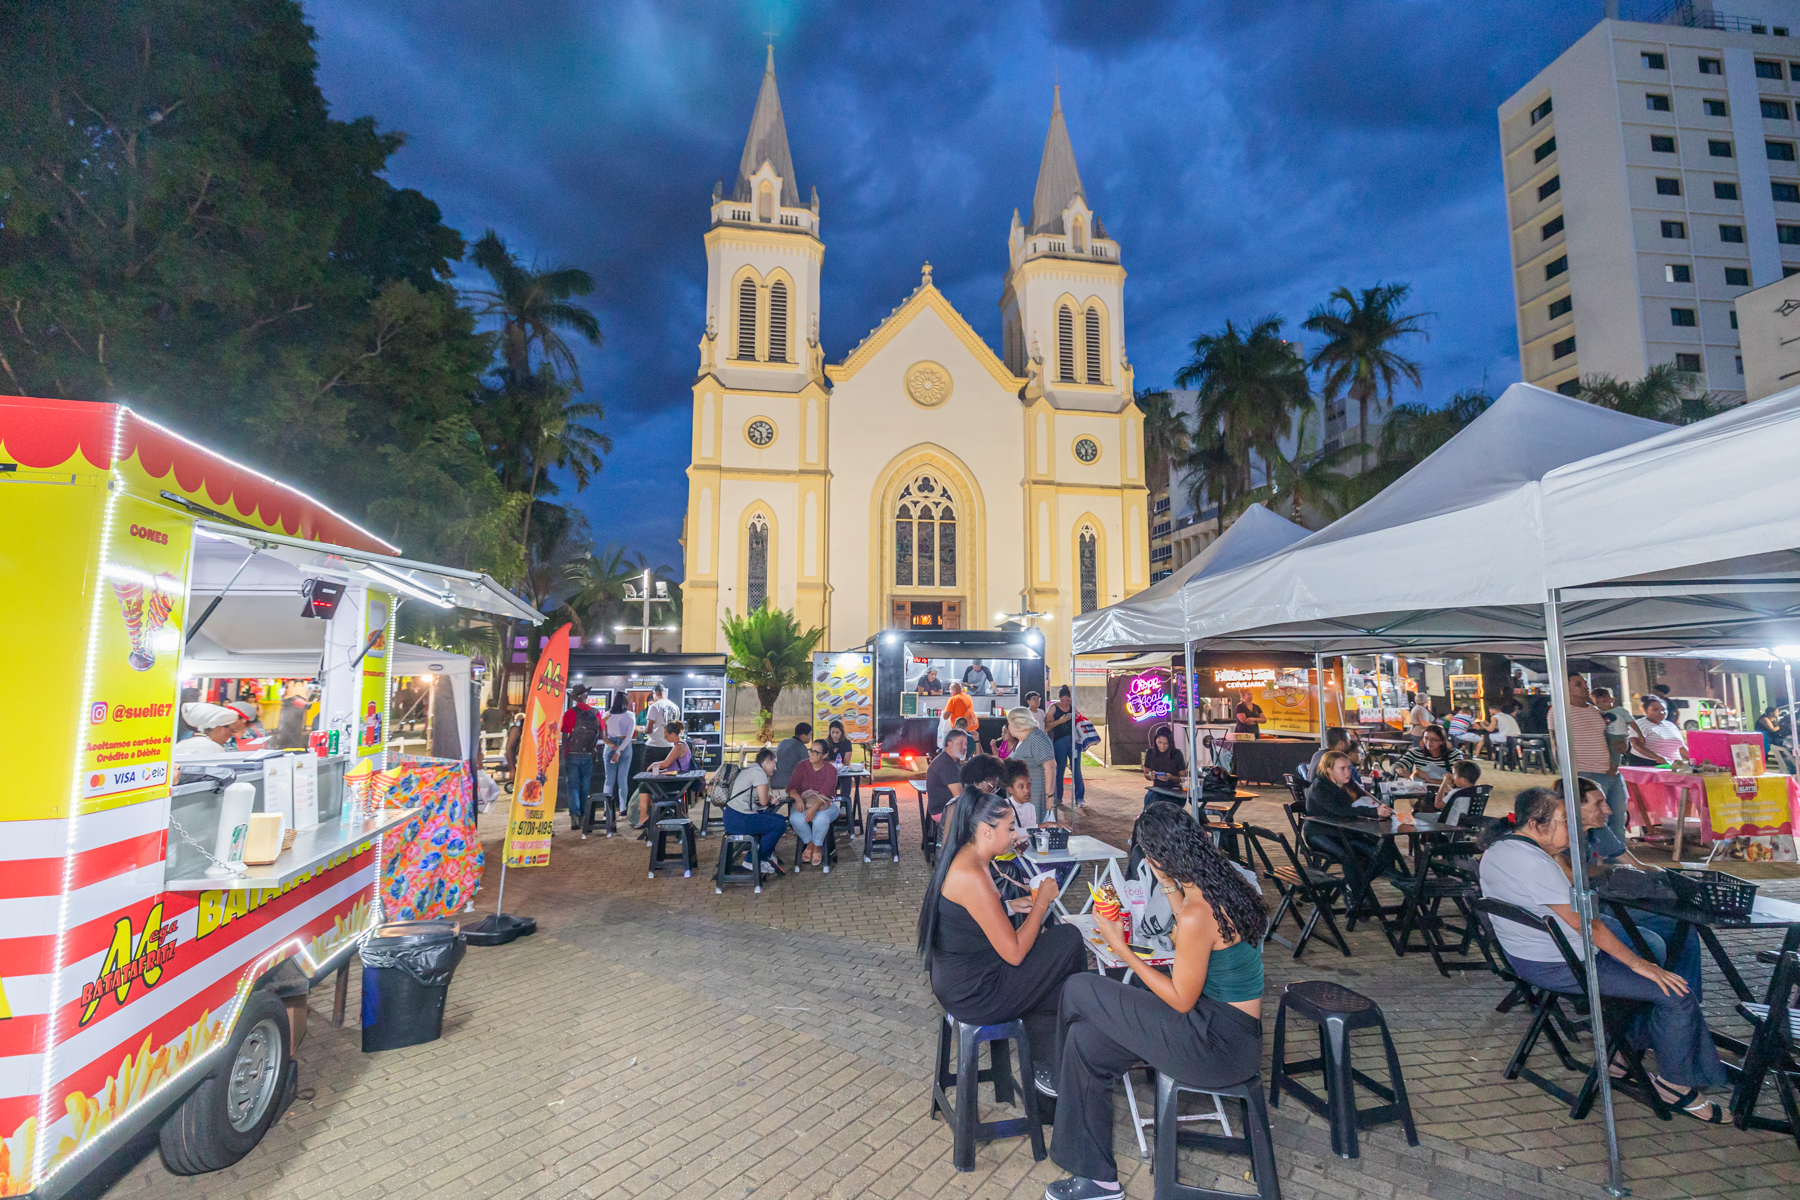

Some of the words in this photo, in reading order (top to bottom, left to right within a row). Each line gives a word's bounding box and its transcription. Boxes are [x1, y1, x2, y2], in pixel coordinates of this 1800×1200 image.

[130, 524, 168, 545] CONES
[1131, 677, 1161, 693] Chopp
[113, 703, 172, 722] @sueli67
[84, 740, 131, 752] Aceitamos
[132, 736, 161, 747] cartões
[163, 735, 171, 743] de
[97, 750, 129, 762] Crédito
[137, 747, 161, 758] Débito
[114, 771, 135, 785] VISA
[81, 939, 178, 1008] BATATAFRITZ
